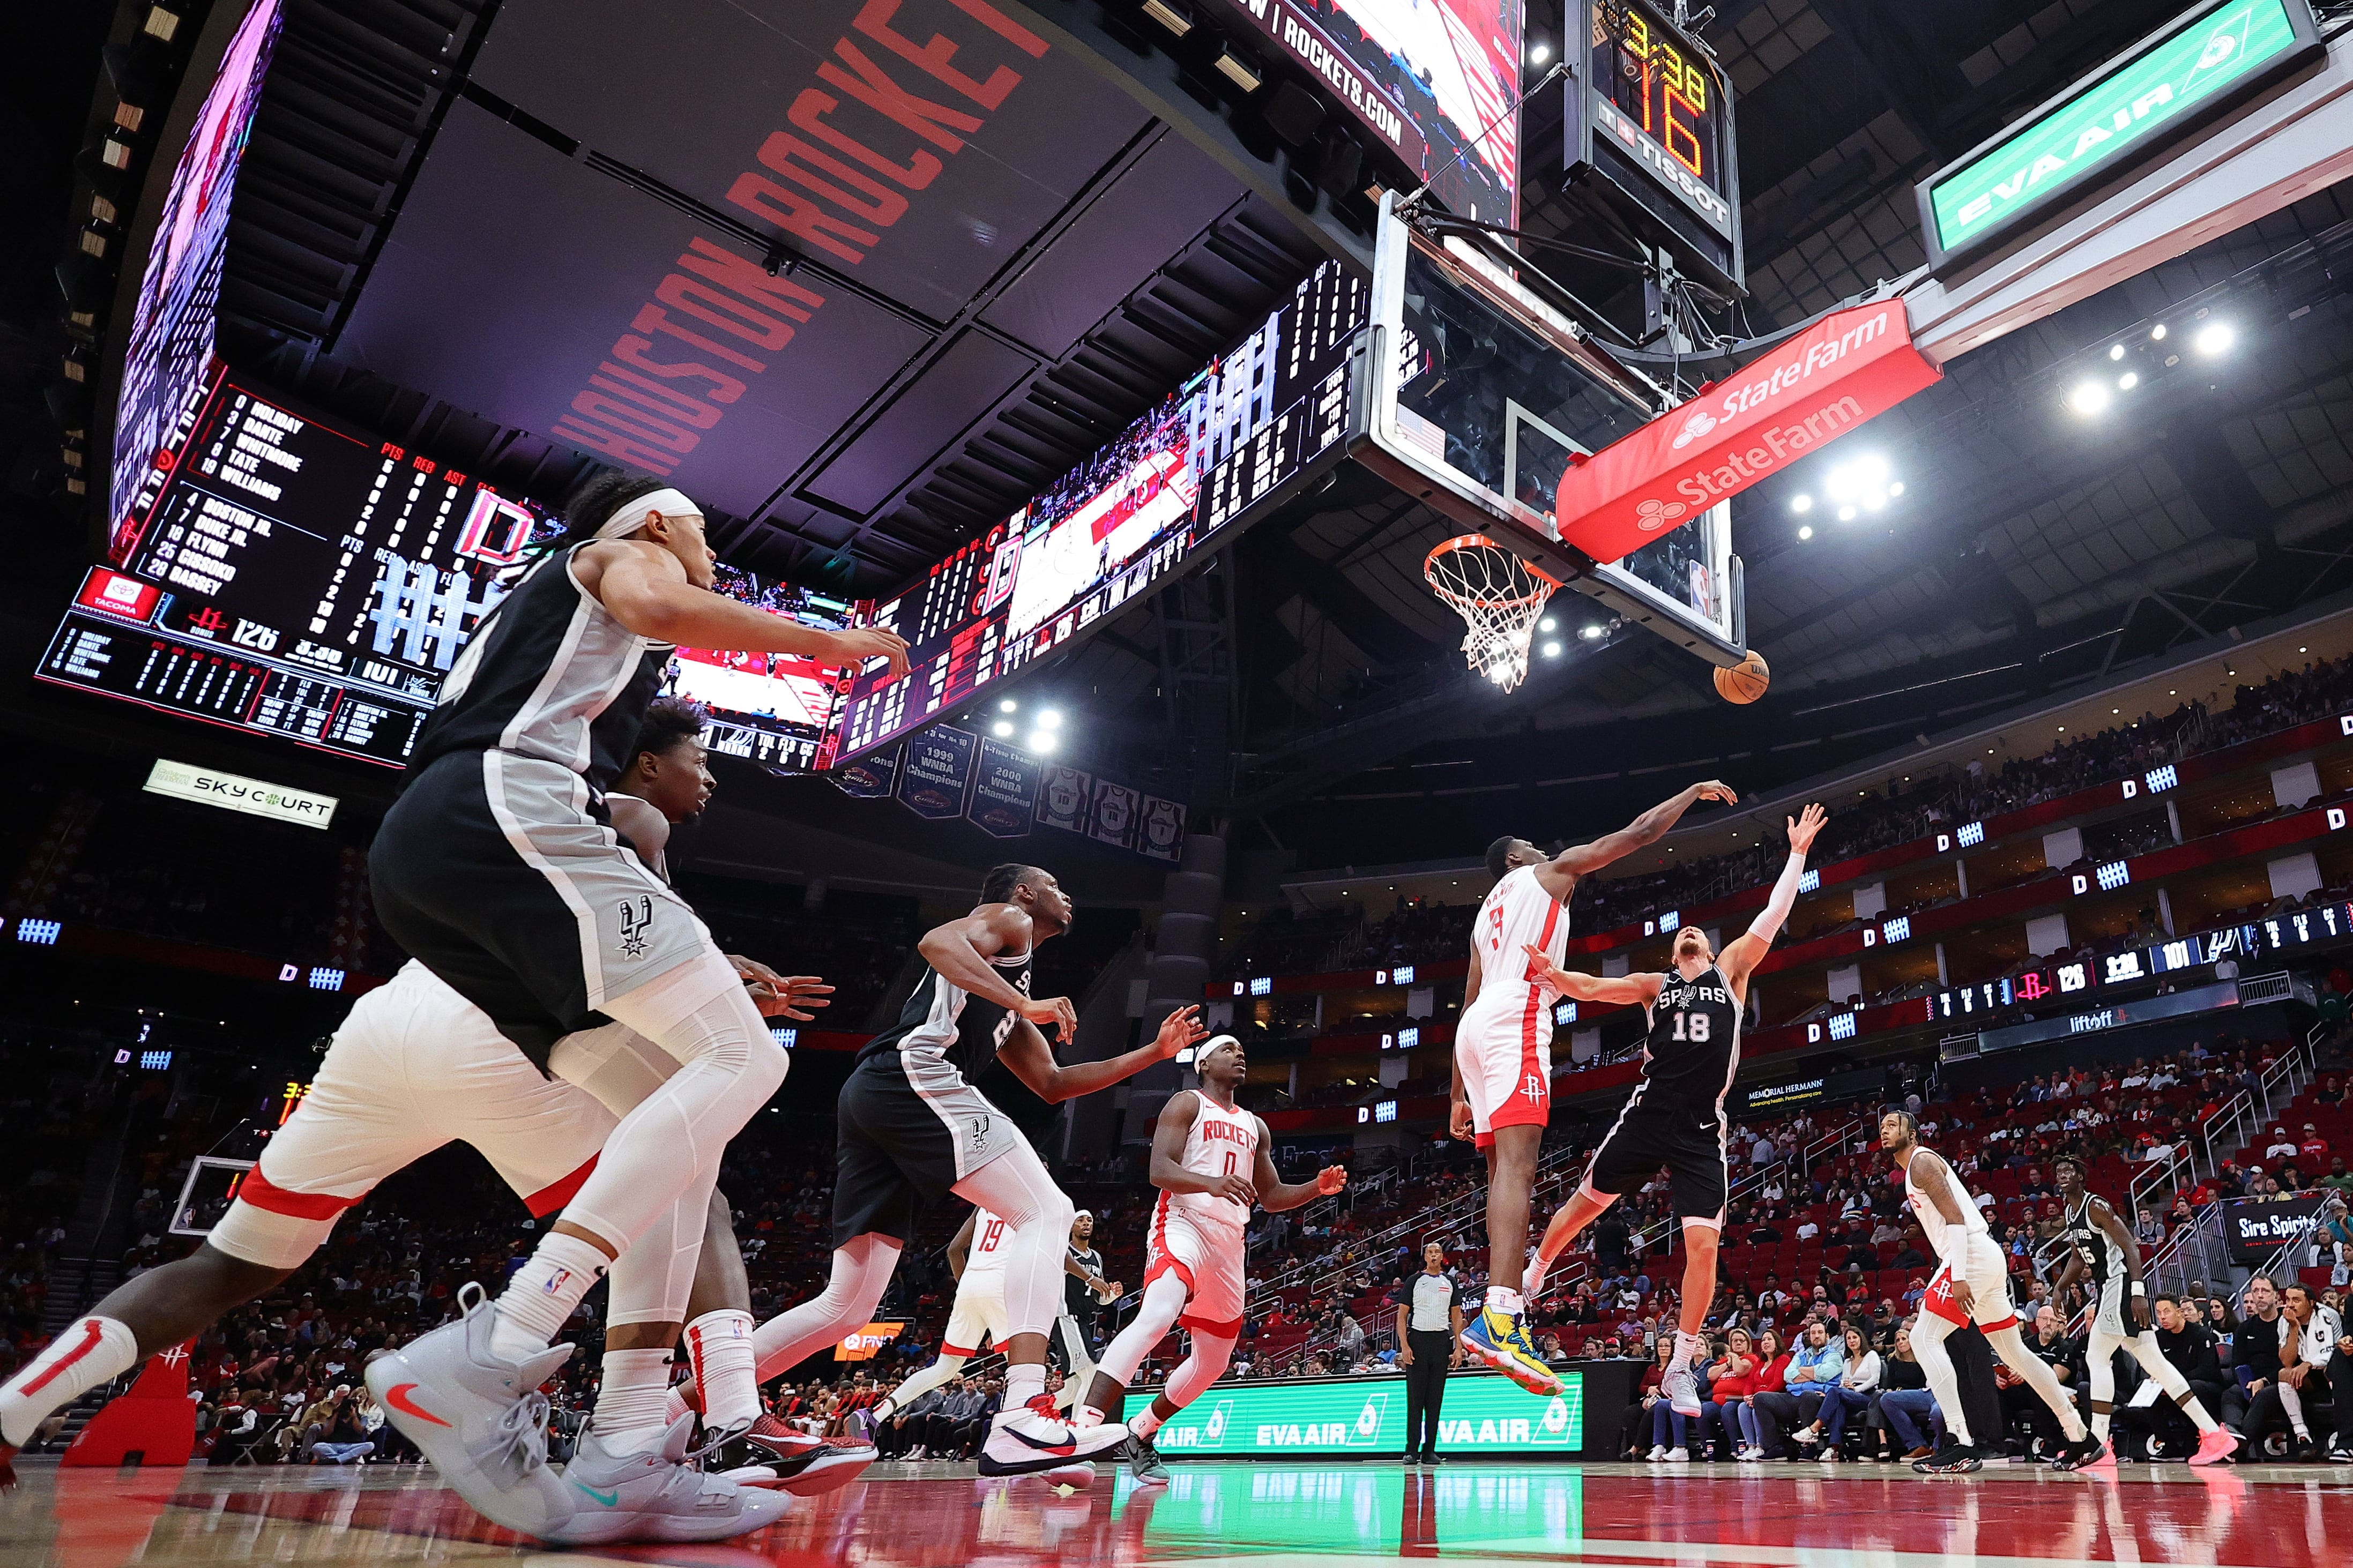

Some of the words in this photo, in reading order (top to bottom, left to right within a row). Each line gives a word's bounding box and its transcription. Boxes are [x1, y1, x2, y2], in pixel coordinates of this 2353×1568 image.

[1284, 15, 1402, 146] ROCKETS.COM
[1637, 133, 1727, 224] TISSOT
[1314, 261, 1327, 282] AST
[552, 236, 826, 476] HOUSTON
[227, 410, 239, 425] 3
[242, 416, 285, 446] DANTE
[235, 394, 247, 409] 0
[250, 401, 304, 434] HOLIDAY
[382, 459, 394, 473] 5
[220, 426, 231, 439] 7
[236, 432, 303, 473] WHITMORE
[403, 504, 412, 517] 1
[433, 516, 445, 529] 2
[380, 442, 405, 461] PTS
[412, 456, 437, 474] REB
[443, 470, 467, 487] AST
[201, 457, 218, 475] 19
[220, 464, 282, 502] WILLIAMS
[211, 442, 223, 457] 8
[228, 448, 261, 474] TATE
[361, 505, 374, 519] 2
[178, 507, 190, 522] 7
[194, 514, 232, 540] DUKE
[228, 528, 248, 548] JR.
[333, 569, 346, 584] 2
[187, 492, 199, 507] 4
[202, 497, 256, 529] BOSTON
[252, 518, 272, 537] JR.
[376, 565, 386, 579] 1
[167, 524, 184, 542] 18
[185, 530, 229, 559] FLYNN
[326, 585, 339, 600] 2
[363, 597, 373, 611] 1
[340, 534, 364, 554] PTS
[407, 560, 426, 575] AS
[155, 541, 177, 560] 25
[177, 548, 237, 582] CISSOKO
[354, 613, 367, 628] 2
[94, 596, 137, 615] TACOMA
[147, 557, 169, 577] 28
[168, 564, 222, 596] BASSEY
[347, 630, 359, 644] 4
[423, 636, 433, 649] 1
[77, 639, 102, 652] DANTE
[190, 626, 214, 639] BONUS
[232, 618, 278, 651] 126
[68, 655, 88, 666] TATE
[758, 733, 776, 750] TOL
[778, 738, 796, 753] FLS
[799, 742, 814, 757] CC
[758, 748, 769, 760] 2
[800, 756, 808, 768] 1
[927, 747, 954, 763] 1999
[906, 764, 963, 789] Champions
[920, 756, 954, 775] WNBA
[995, 766, 1022, 782] 2000
[194, 777, 248, 797] SKY
[977, 784, 1032, 808] Champions
[990, 776, 1022, 794] WNBA
[1490, 904, 1503, 951] 3
[2264, 919, 2280, 933] TOL
[2292, 913, 2308, 928] FLS
[2322, 907, 2335, 921] CC
[2057, 964, 2086, 993] 126
[2161, 940, 2191, 971] 101
[2270, 932, 2281, 949] 2
[2327, 920, 2337, 936] 1
[1960, 988, 1972, 1000] FLS
[1985, 993, 1993, 1008] 1
[1672, 1011, 1710, 1043] 18
[2070, 1010, 2113, 1033] liftoff
[1748, 1087, 1785, 1101] MEMORIAL
[1785, 1078, 1823, 1094] HERMANN
[1749, 1099, 1770, 1108] Advancing
[1785, 1091, 1813, 1101] Personalizing
[1203, 1120, 1257, 1158] ROCKETS
[1224, 1151, 1236, 1176] 0
[978, 1220, 1005, 1252] 19
[2238, 1217, 2269, 1238] Sire
[2269, 1214, 2318, 1239] Spirits
